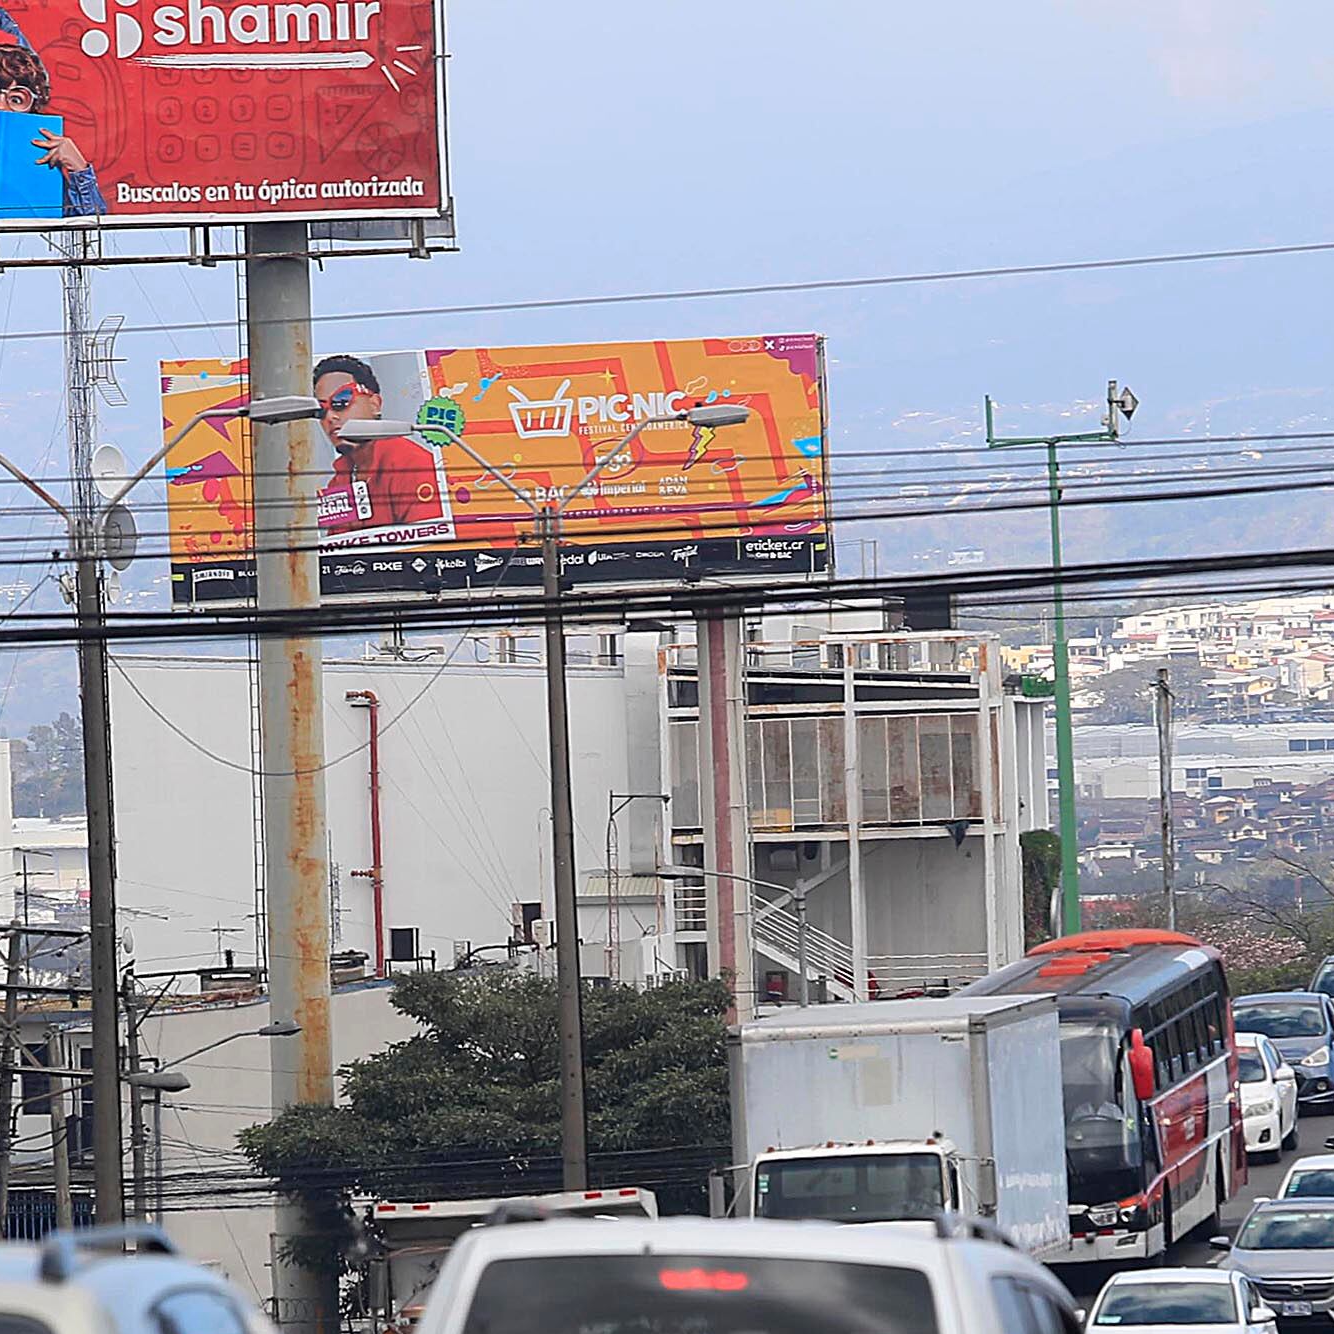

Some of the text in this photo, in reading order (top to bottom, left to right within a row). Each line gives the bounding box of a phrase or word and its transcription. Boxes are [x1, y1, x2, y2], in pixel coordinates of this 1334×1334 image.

[154, 0, 380, 45] shamir
[117, 175, 424, 205] Buscalos en tu óptica autorizada
[427, 407, 456, 421] PIC
[374, 524, 450, 544] TOWERS
[372, 561, 403, 571] AXE
